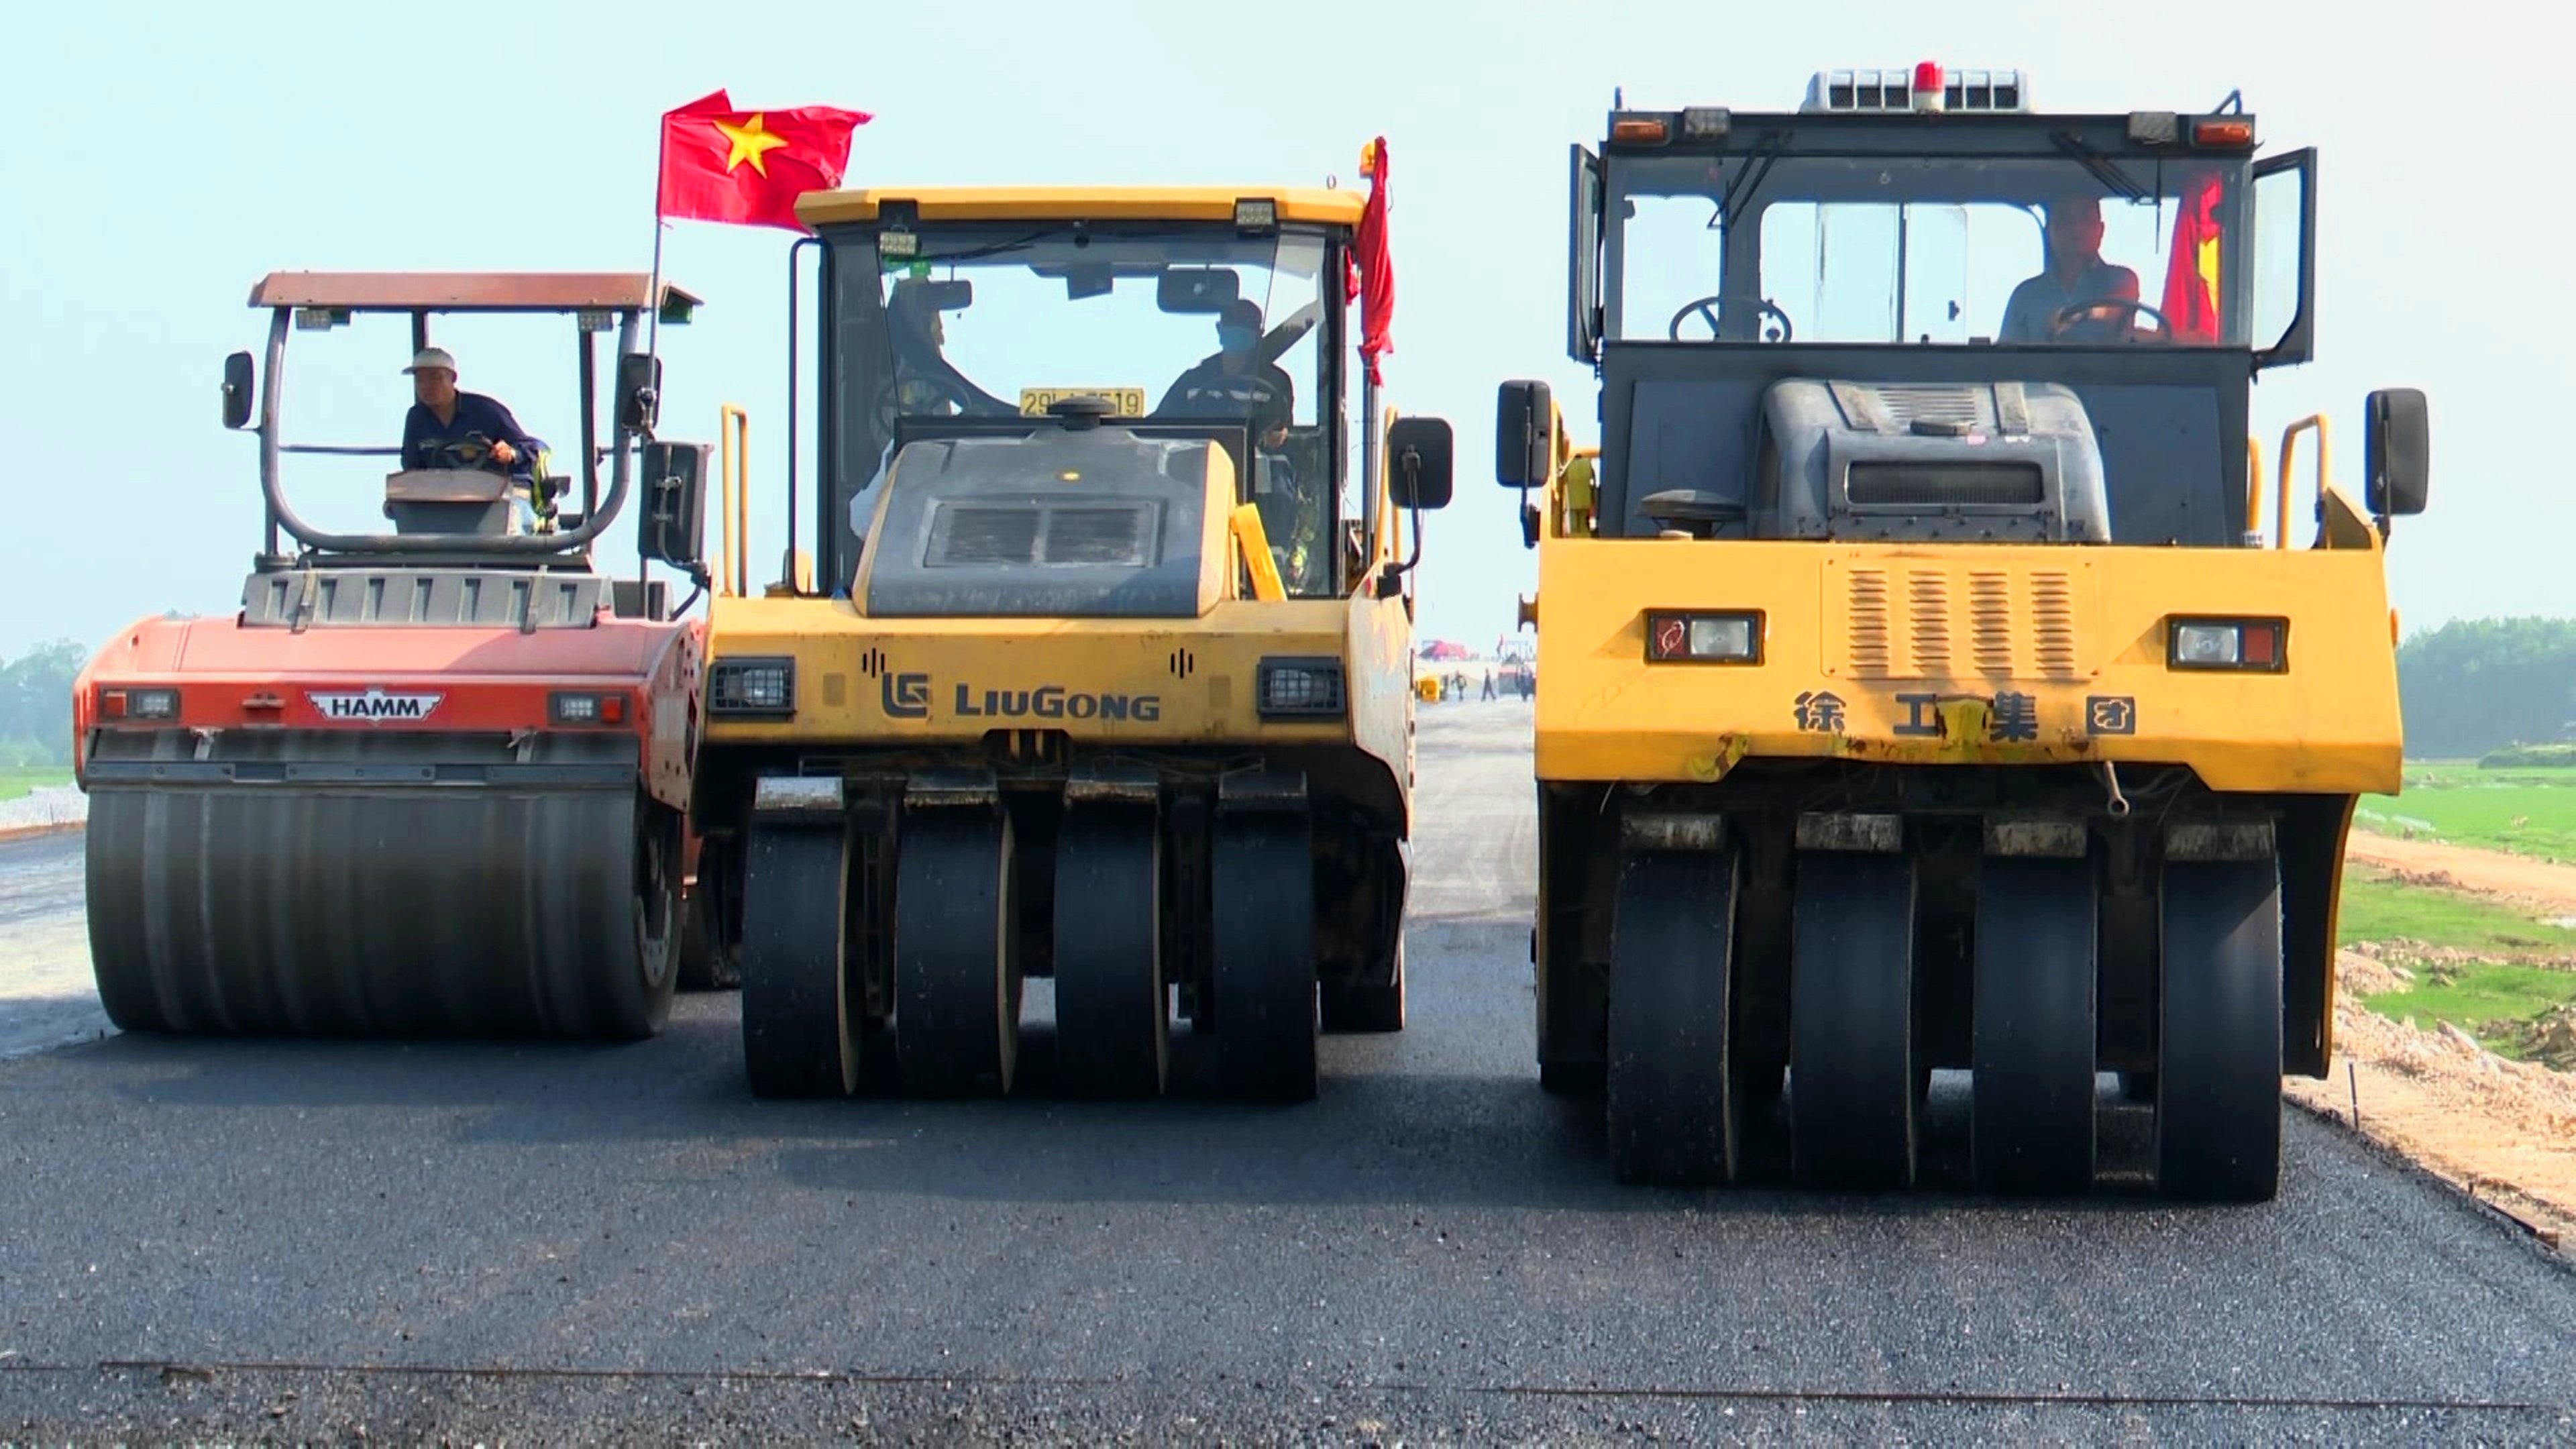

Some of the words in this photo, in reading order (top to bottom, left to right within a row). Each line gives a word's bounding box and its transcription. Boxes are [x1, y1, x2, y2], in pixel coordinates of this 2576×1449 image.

[332, 698, 421, 716] HAMM
[1794, 690, 2136, 743] 徐工集团
